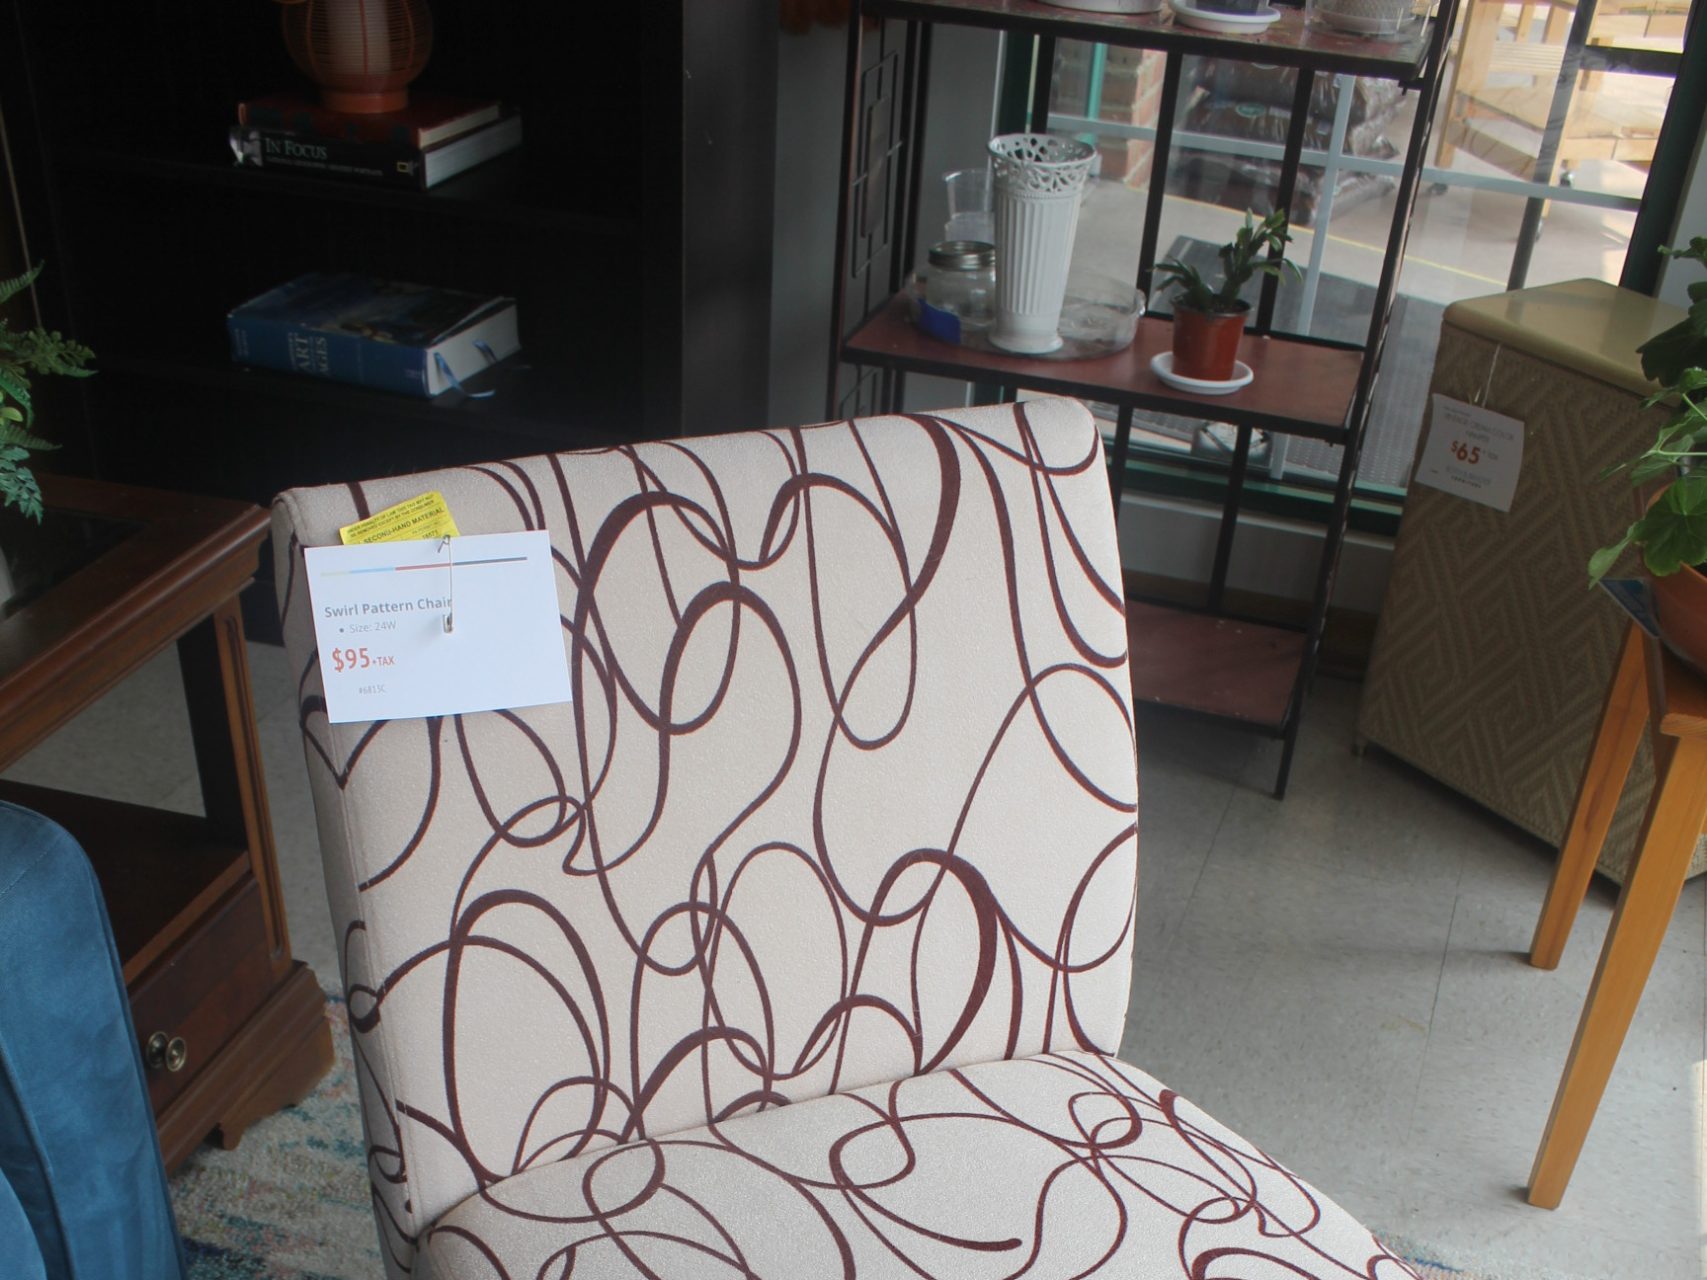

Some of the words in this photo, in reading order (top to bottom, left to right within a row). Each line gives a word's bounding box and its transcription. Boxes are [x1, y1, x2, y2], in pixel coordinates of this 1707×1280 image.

[266, 138, 281, 154] IN
[284, 139, 328, 160] FOCUS
[296, 334, 310, 371] ART
[1450, 440, 1480, 464] $65
[411, 507, 444, 524] MATERIAL
[325, 604, 359, 618] Swirl
[362, 601, 414, 615] Pattern
[417, 596, 453, 610] Chair
[350, 623, 372, 633] Size:
[375, 621, 397, 631] 24W
[332, 647, 370, 672] $95
